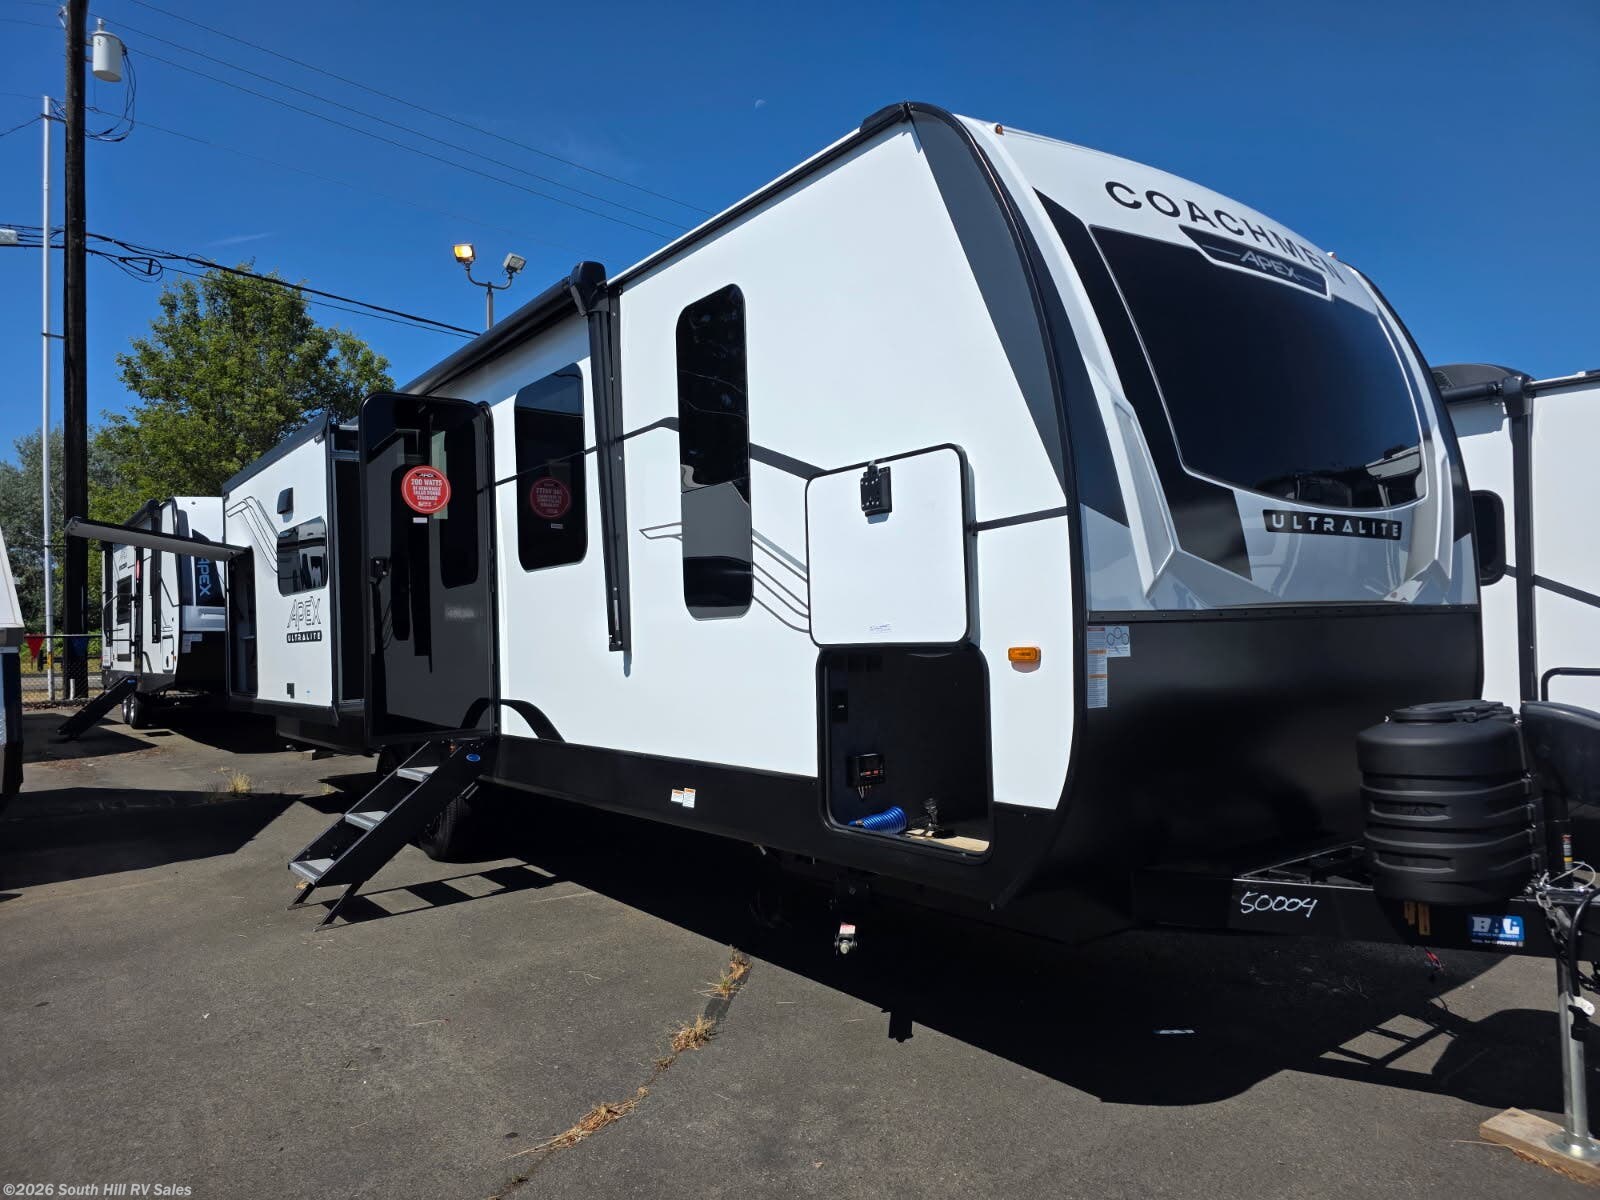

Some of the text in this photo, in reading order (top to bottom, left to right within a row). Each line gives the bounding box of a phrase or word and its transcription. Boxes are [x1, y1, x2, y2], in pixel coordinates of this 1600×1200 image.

[1105, 181, 1346, 285] COACHMEN
[1240, 250, 1300, 281] APEX
[424, 479, 443, 487] WATTS
[1271, 513, 1399, 537] ULTRALITE
[286, 596, 322, 631] APEX
[287, 631, 321, 642] ULTRALITE
[1240, 891, 1318, 918] 50004
